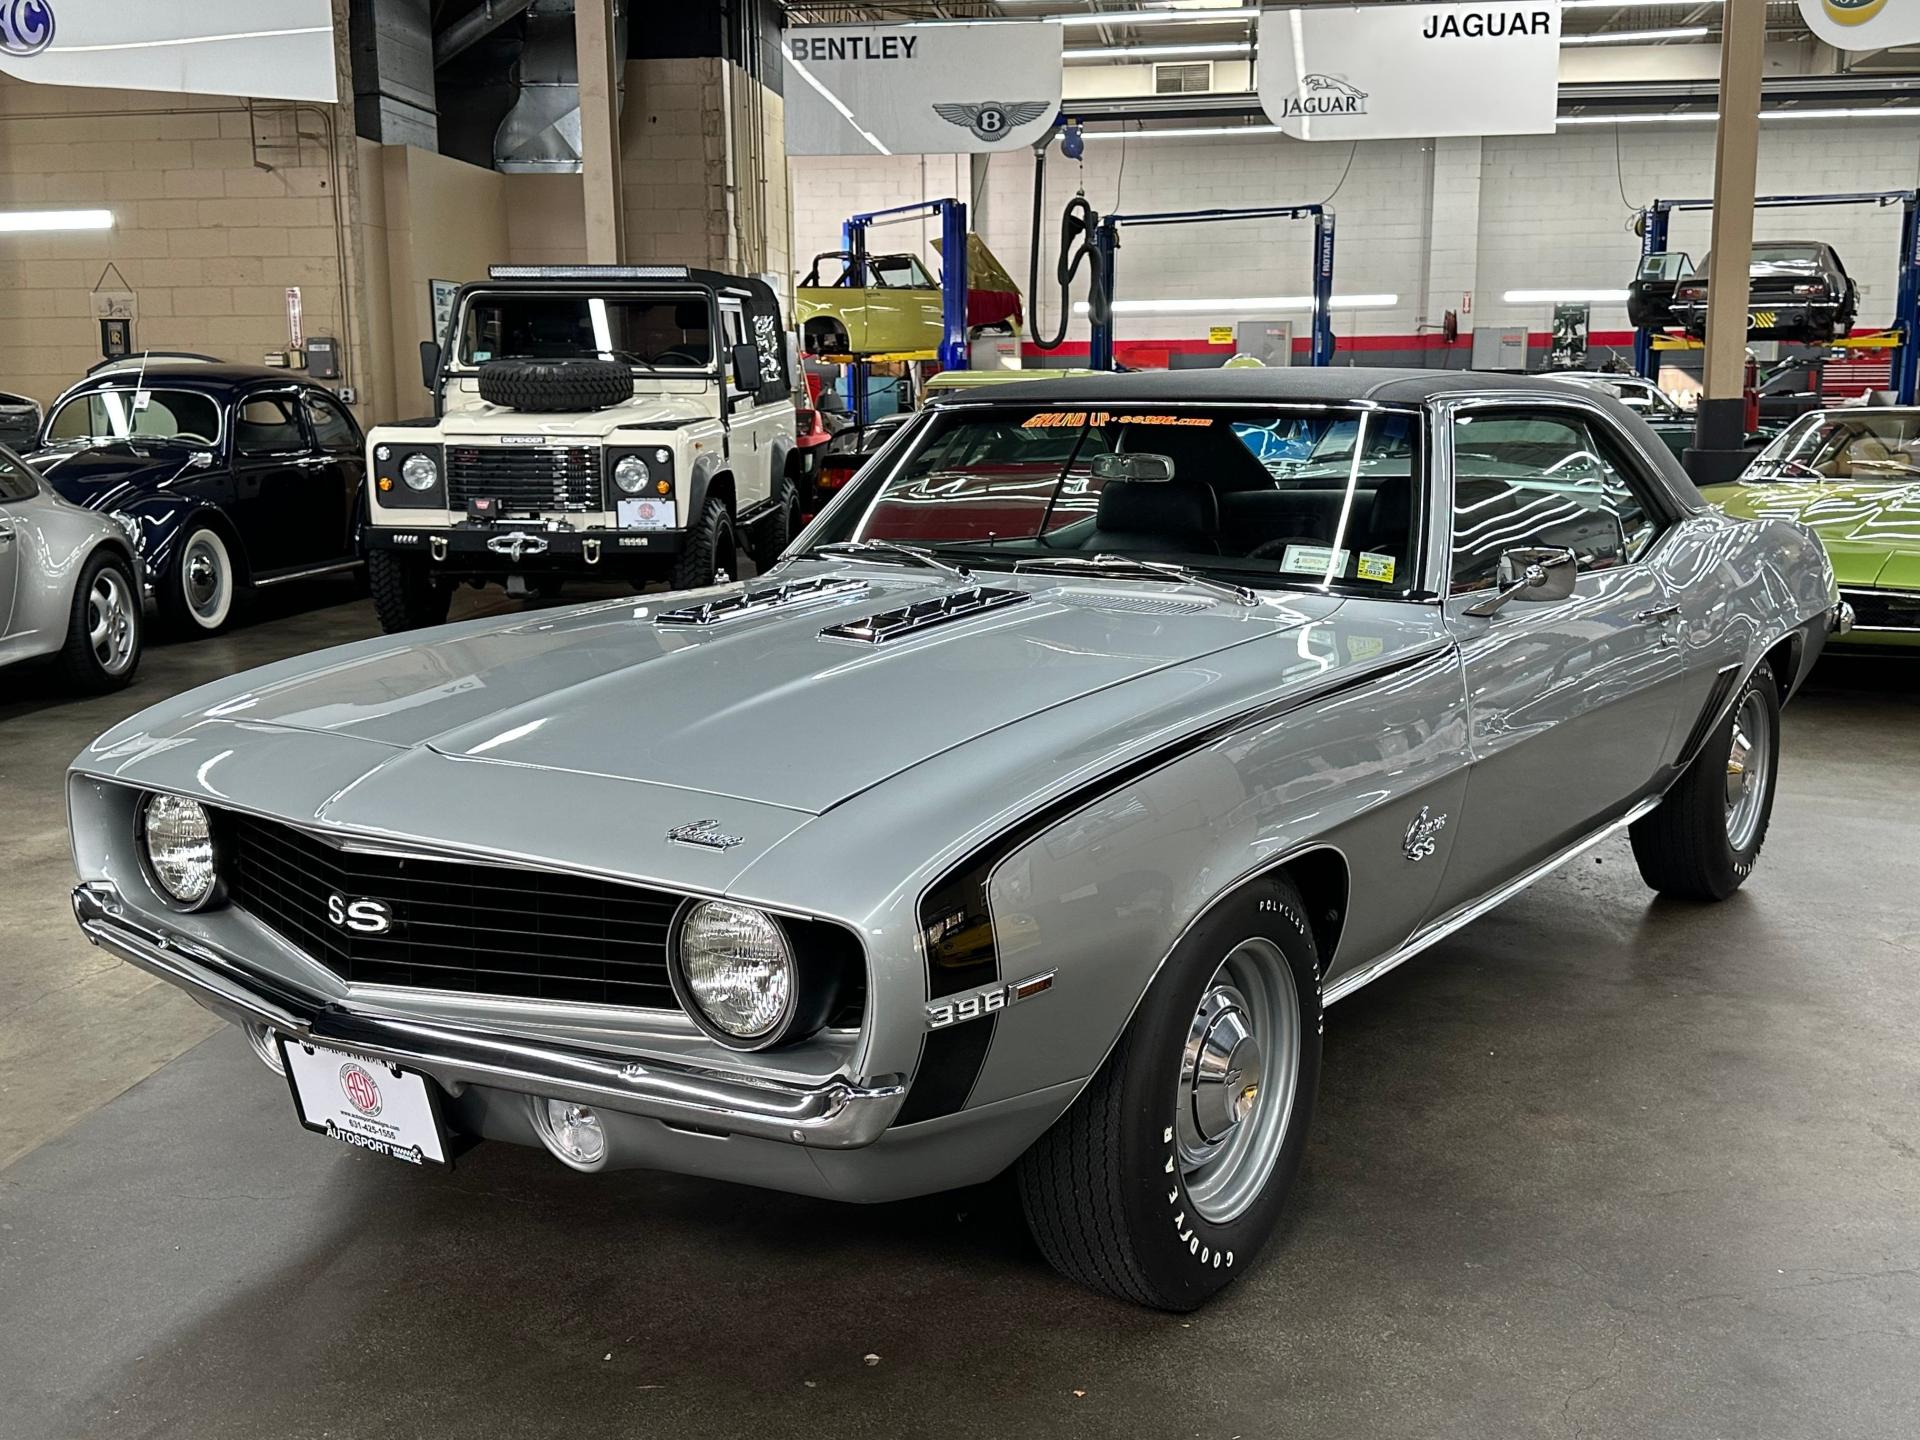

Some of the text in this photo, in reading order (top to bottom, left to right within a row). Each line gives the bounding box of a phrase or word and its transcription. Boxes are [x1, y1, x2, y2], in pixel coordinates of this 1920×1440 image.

[1423, 11, 1550, 39] JAGUAR
[791, 36, 917, 60] BENTLEY
[1281, 96, 1357, 118] JAGUAR
[979, 110, 1000, 131] B
[1322, 236, 1331, 272] ROTARY
[1021, 412, 1087, 428] GROUND
[1089, 412, 1110, 427] UP
[1364, 568, 1381, 576] 2023
[1407, 836, 1435, 861] SS
[328, 894, 388, 932] SS
[927, 988, 1005, 1028] 396
[326, 1127, 390, 1155] AUTOSPORT
[349, 1119, 396, 1140] 631-425-1555
[1164, 1126, 1234, 1268] GOODYEAR
